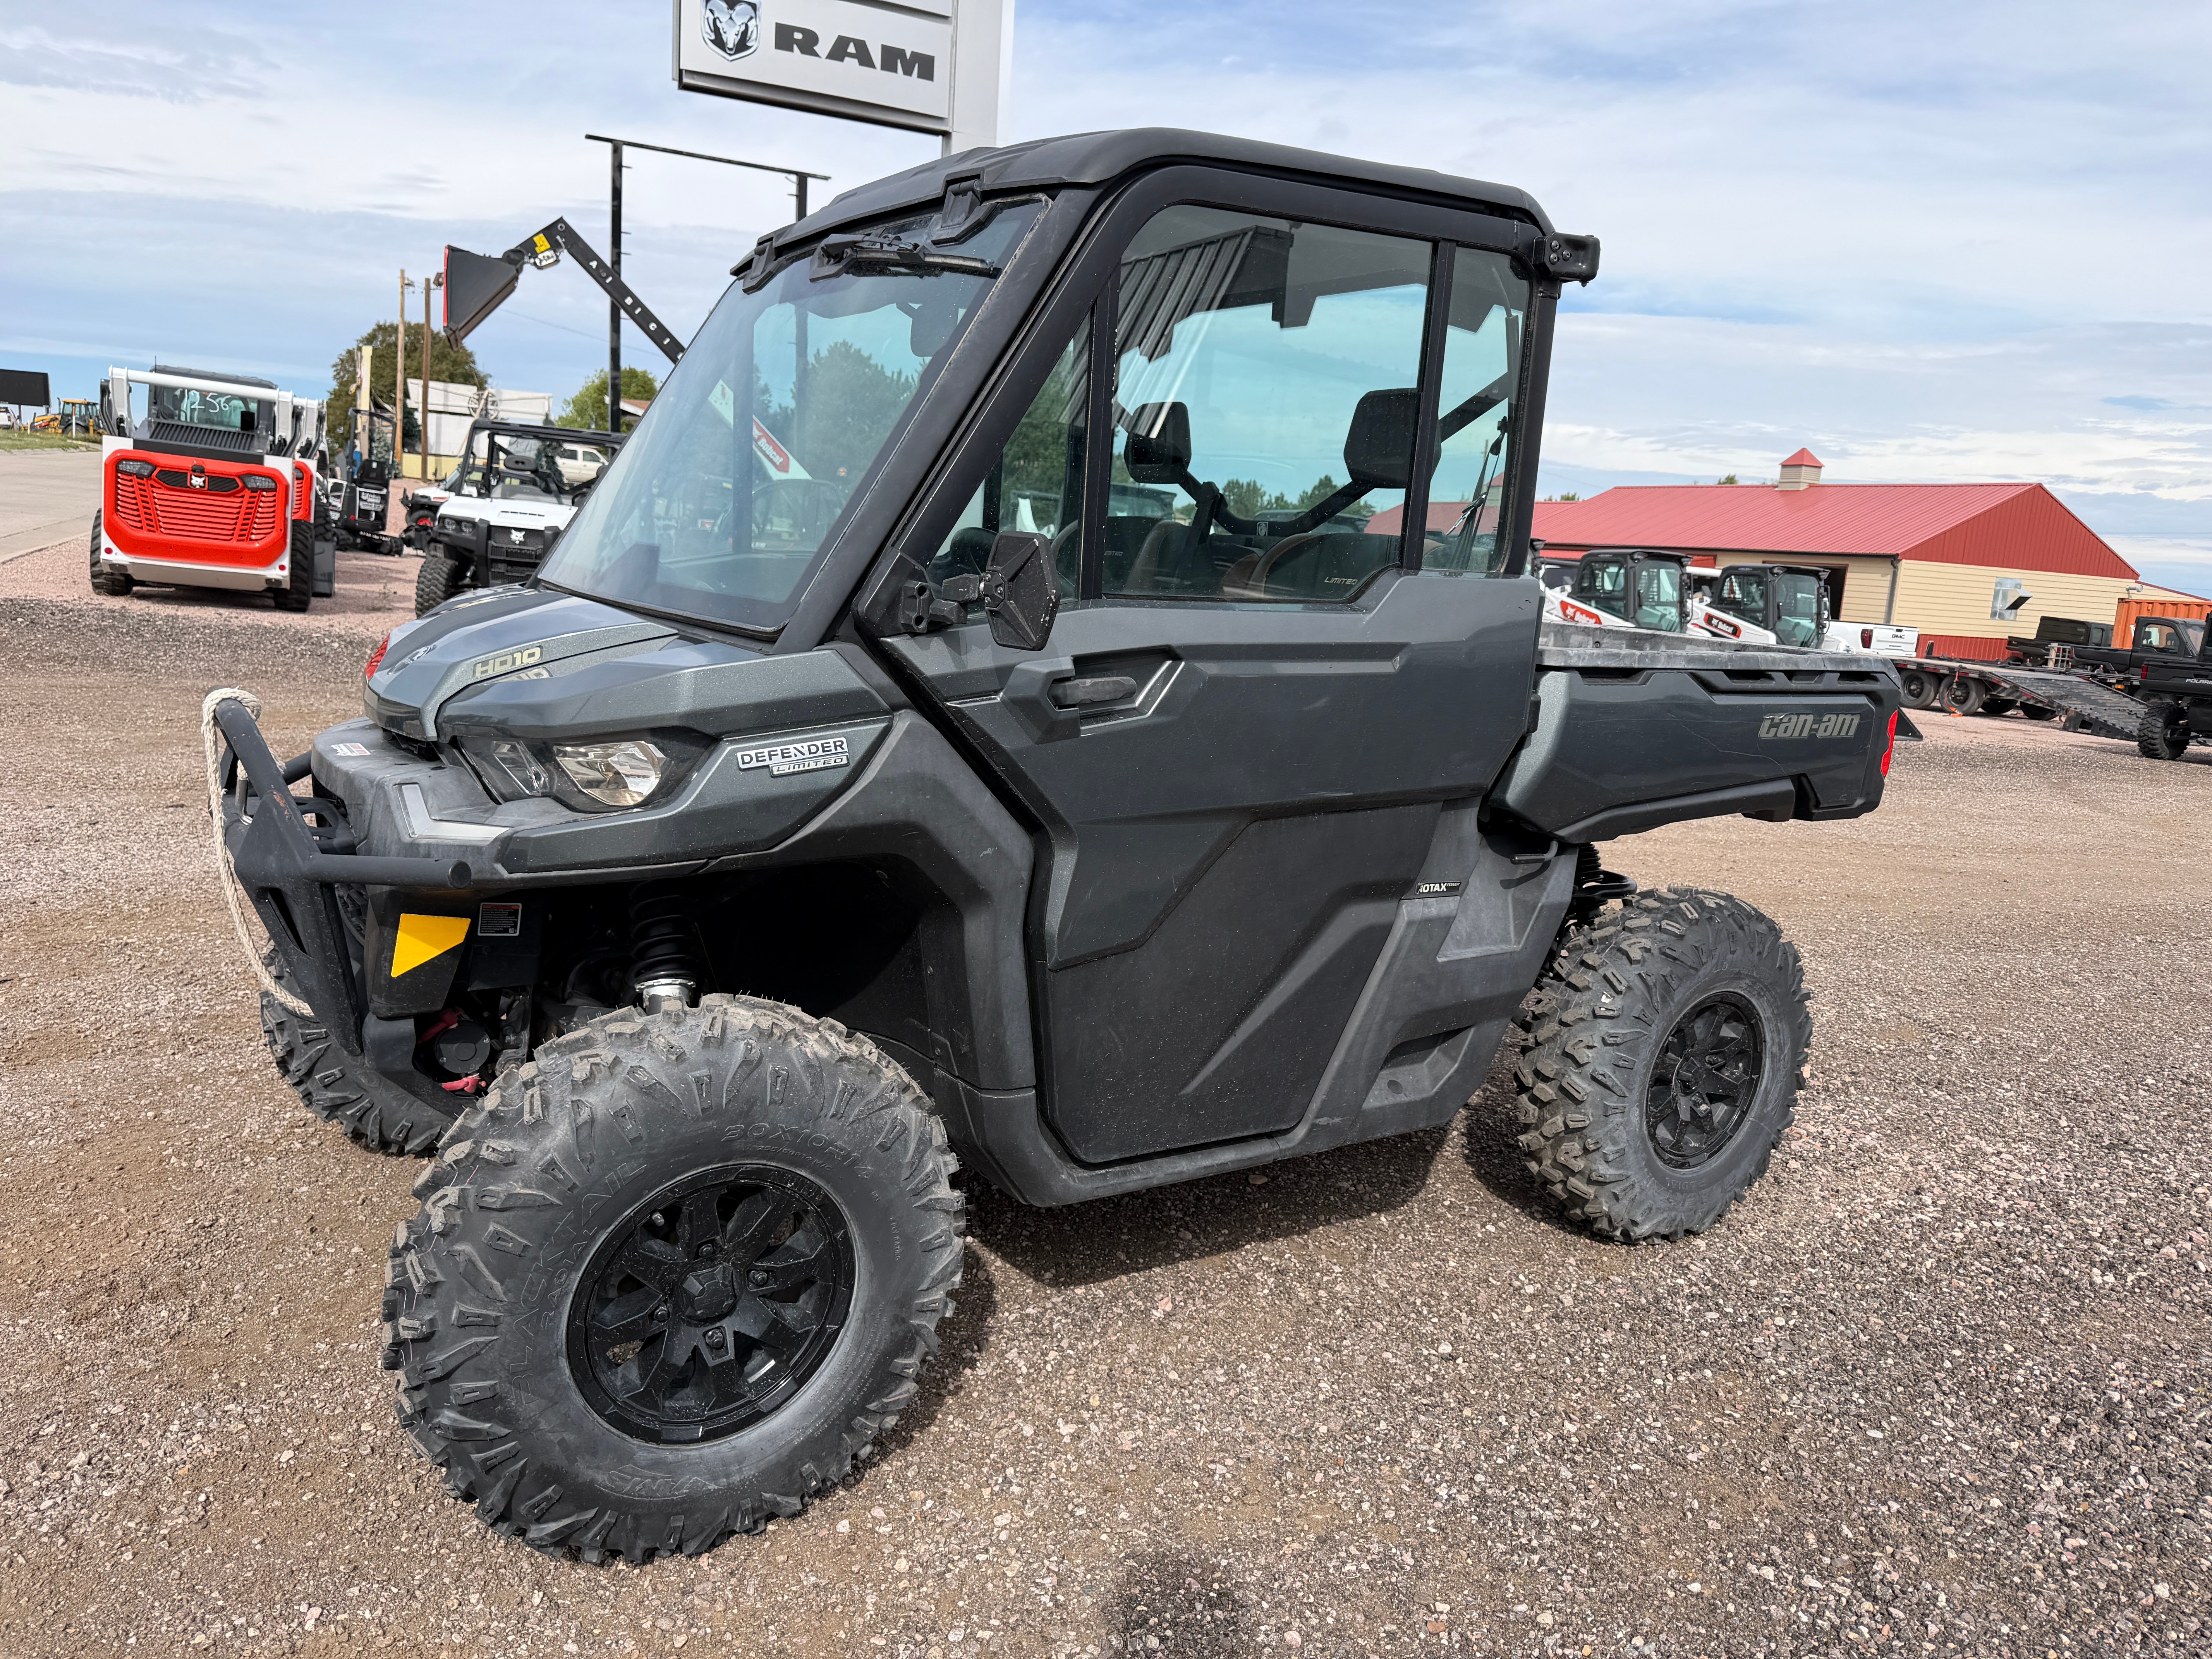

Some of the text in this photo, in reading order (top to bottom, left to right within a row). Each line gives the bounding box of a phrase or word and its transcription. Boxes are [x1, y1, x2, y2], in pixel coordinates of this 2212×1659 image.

[775, 22, 935, 82] RAM
[757, 437, 783, 465] Bobcat
[1324, 577, 1358, 585] LIMITED
[475, 647, 541, 677] HD10
[1760, 714, 1860, 737] can-am
[740, 740, 846, 765] DEFENDER
[777, 757, 843, 772] LIMITED
[721, 1123, 874, 1180] 30X10R14
[511, 1163, 647, 1405] BLACKTAIL
[541, 1226, 597, 1330] RADIAL
